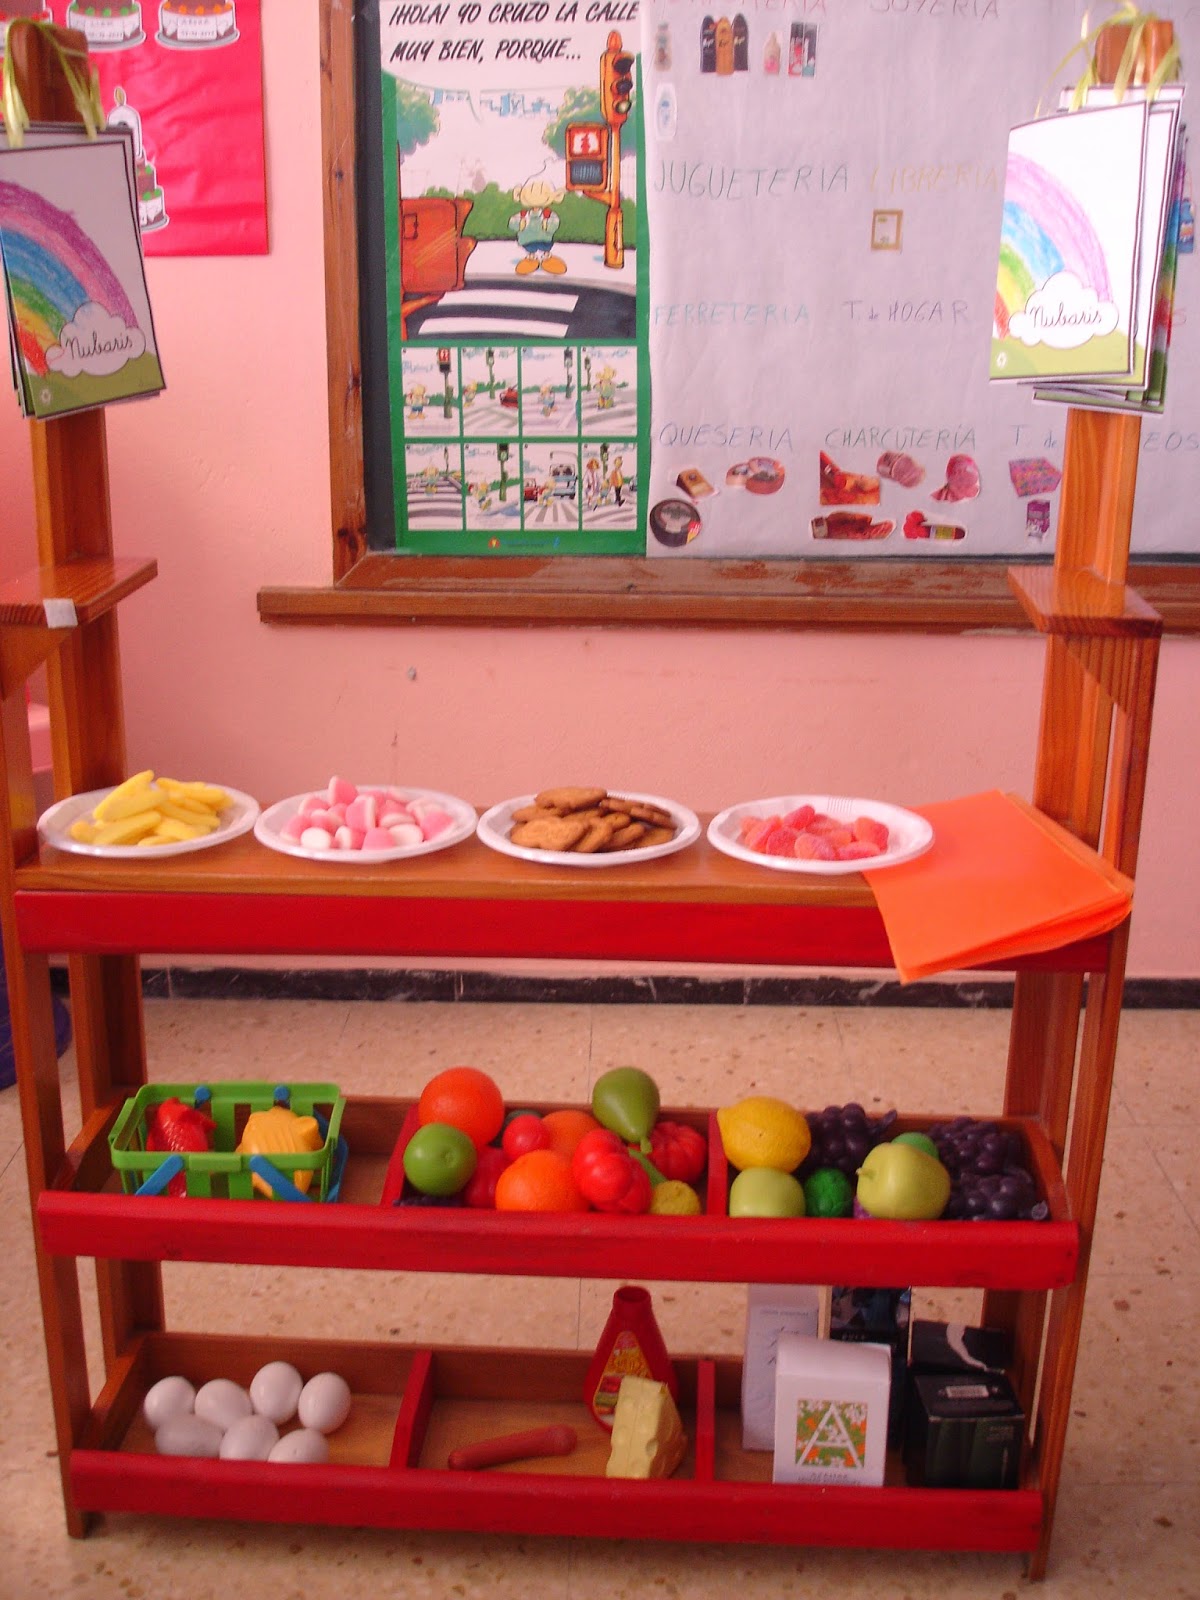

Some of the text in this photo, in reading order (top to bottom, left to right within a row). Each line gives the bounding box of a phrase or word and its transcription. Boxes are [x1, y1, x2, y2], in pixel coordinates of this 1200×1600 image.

[457, 4, 482, 24] YO
[488, 2, 549, 23] CRUZO
[555, 2, 578, 22] LA
[585, 1, 640, 22] CALLE
[390, 41, 434, 62] MUY
[438, 40, 484, 64] BIEN,
[653, 160, 848, 200] JUGUETERIA
[888, 300, 969, 324] HOGAR
